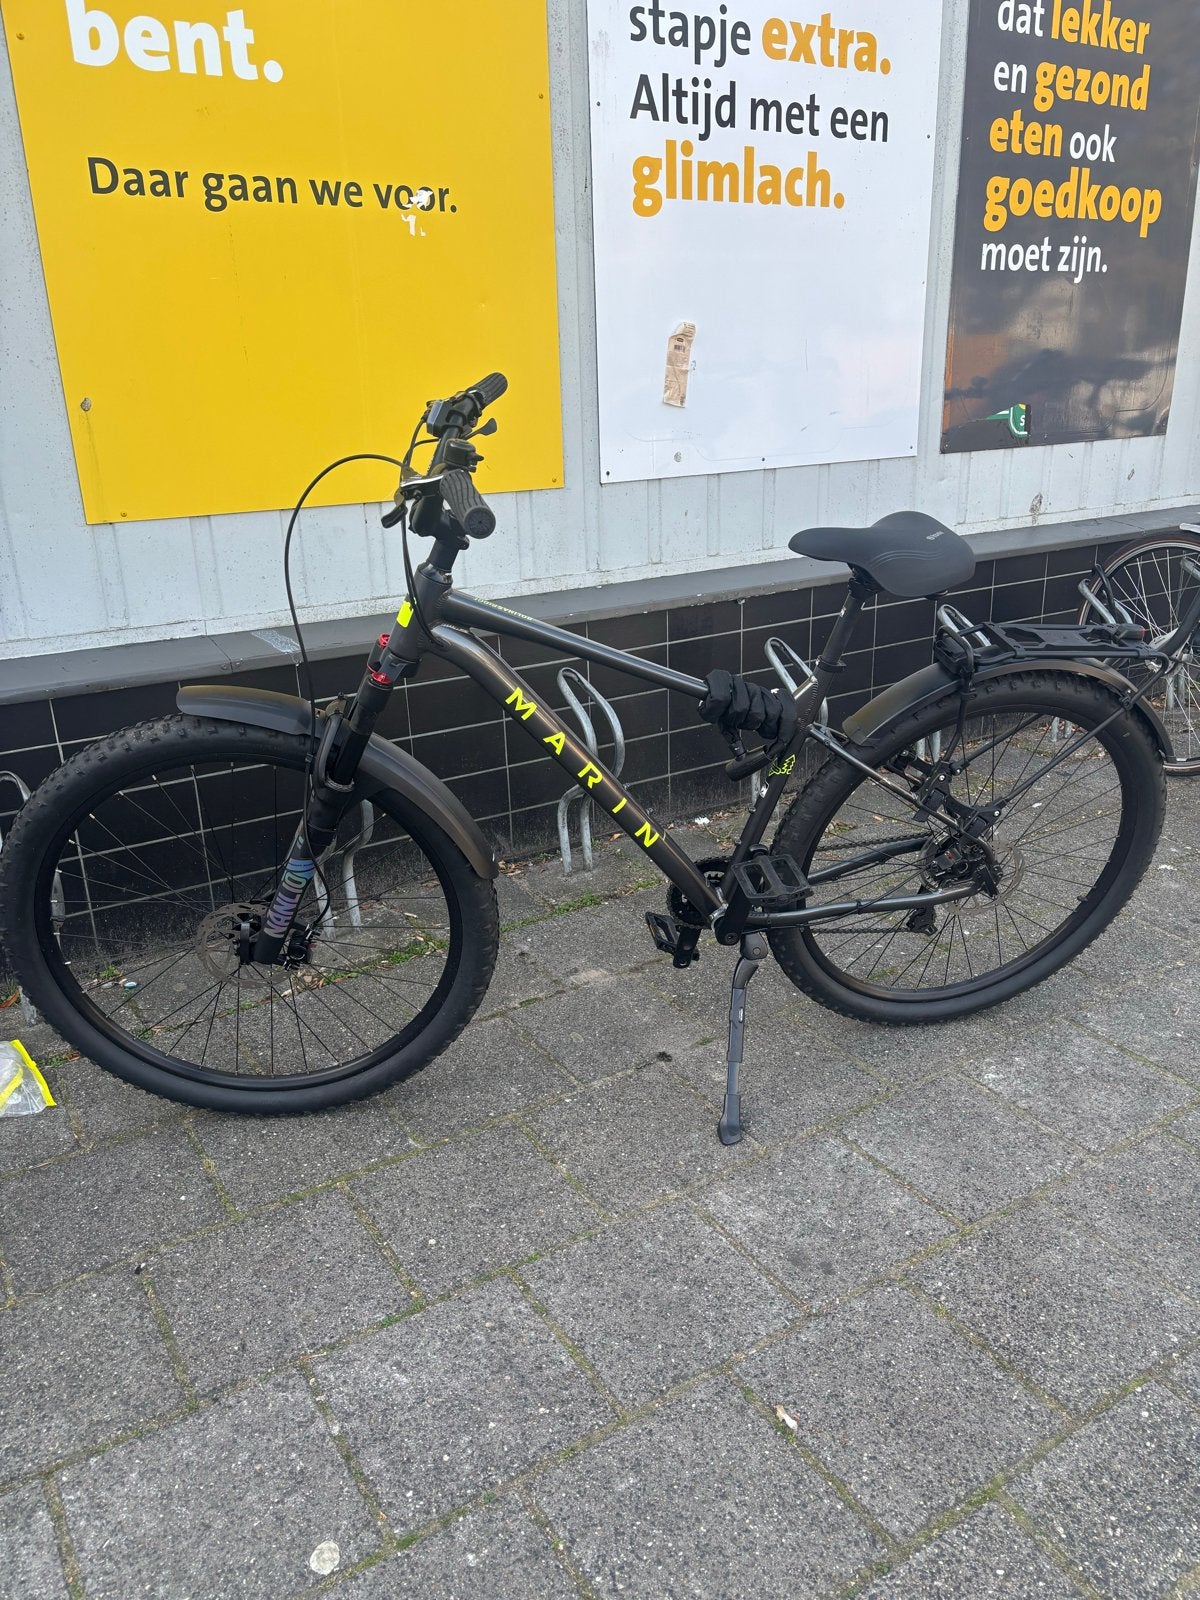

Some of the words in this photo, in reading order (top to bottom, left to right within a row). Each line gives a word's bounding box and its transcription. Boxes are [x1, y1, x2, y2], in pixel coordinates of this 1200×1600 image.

[65, 0, 283, 83] bent.
[629, 0, 750, 68] stapje
[762, 13, 891, 75] extra.
[997, 0, 1045, 37] dat
[1051, 0, 1150, 54] lekker
[629, 73, 736, 142] Altijd
[750, 93, 820, 137] met
[830, 106, 889, 143] een
[993, 61, 1027, 93] en
[1034, 62, 1150, 112] gezond
[989, 109, 1062, 157] eten
[1069, 124, 1118, 162] ook
[87, 157, 189, 197] Daar
[203, 172, 298, 212] gaan
[308, 179, 363, 208] we
[372, 183, 457, 213] voor.
[632, 139, 845, 217] glimlach.
[983, 167, 1163, 238] goedkoop
[980, 236, 1051, 272] moet
[1057, 235, 1108, 283] zijn.
[505, 687, 660, 848] MARIN
